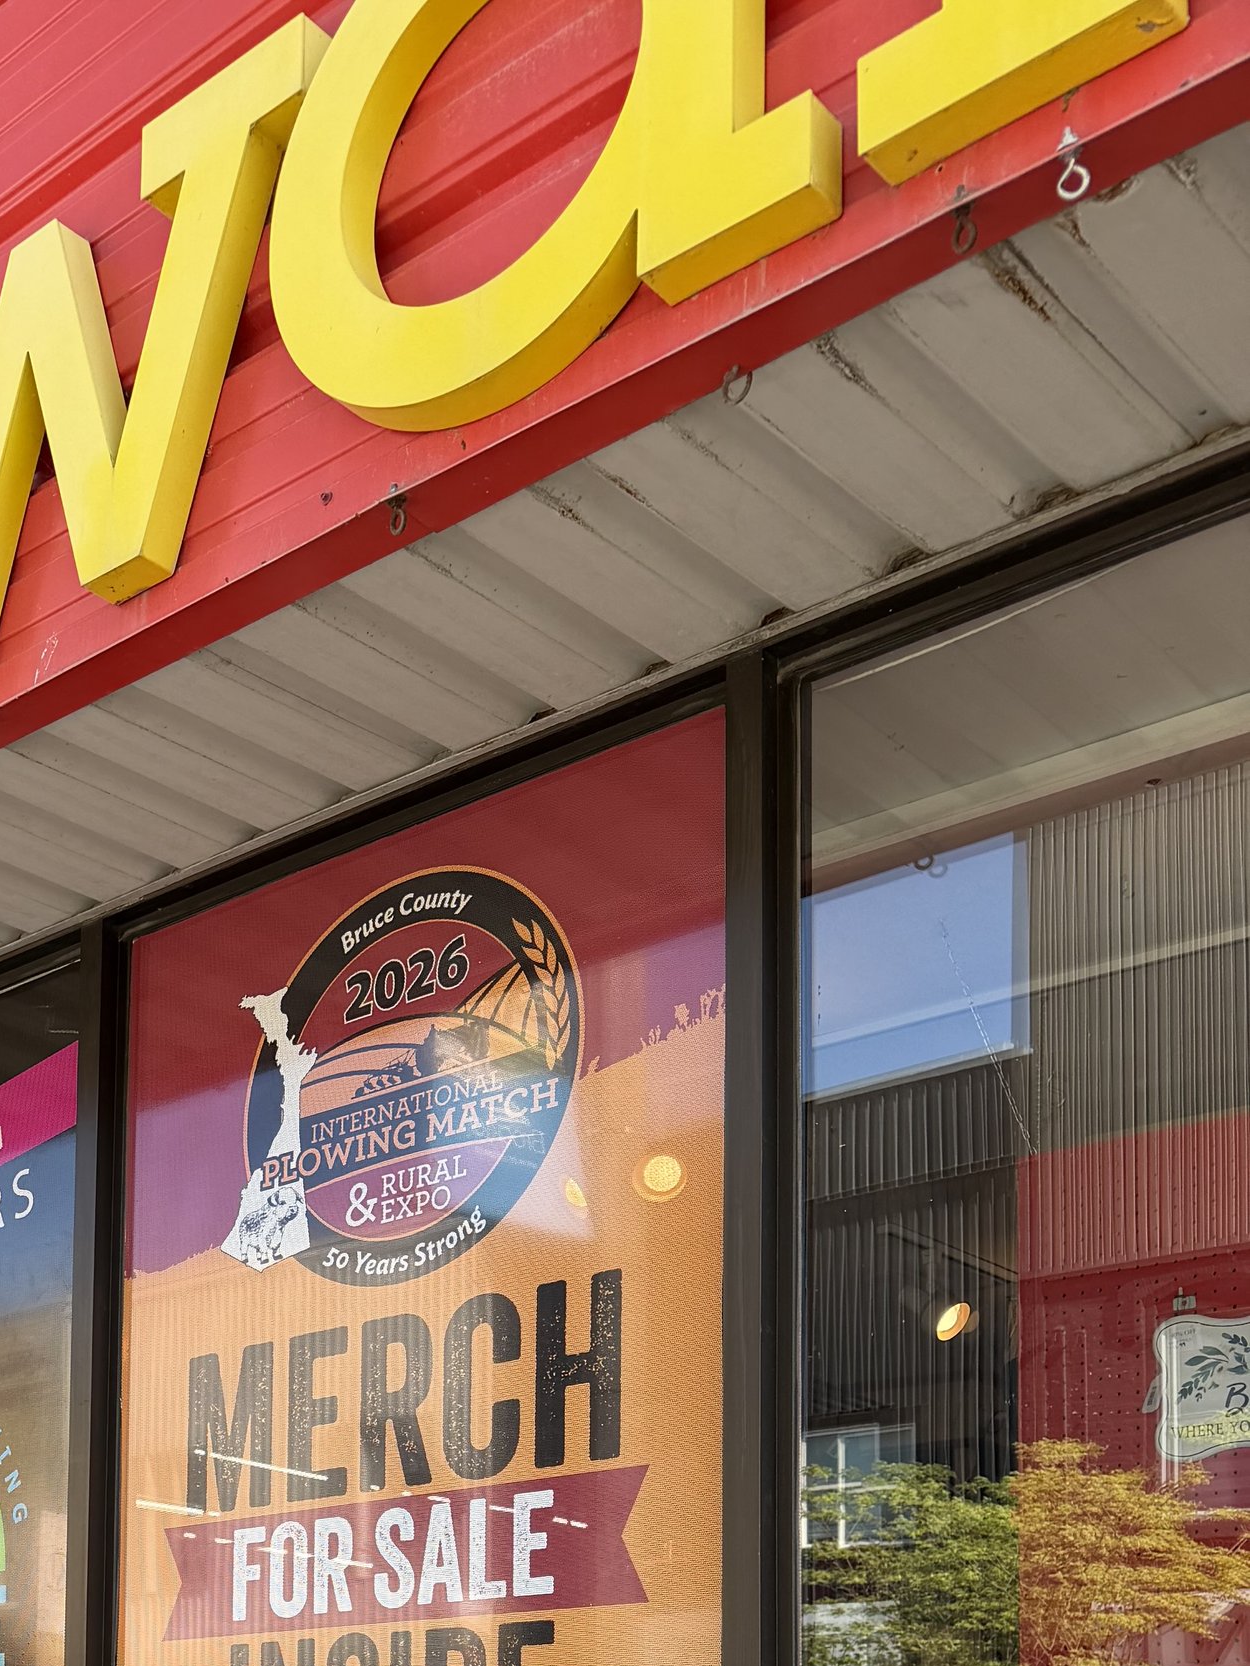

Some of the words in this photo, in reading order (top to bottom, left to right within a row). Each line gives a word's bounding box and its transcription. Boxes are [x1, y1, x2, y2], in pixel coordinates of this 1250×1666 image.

[340, 905, 395, 955] Bruce
[399, 889, 473, 916] County
[344, 933, 470, 1024] 2026
[261, 1118, 415, 1190] PLOWING
[425, 1077, 560, 1143] MATCH
[311, 1070, 504, 1144] INTERNATIONAL
[345, 1181, 377, 1228] &
[381, 1154, 467, 1191] RURAL
[380, 1186, 452, 1225] EXPO
[323, 1247, 350, 1269] 50
[354, 1250, 409, 1275] Years
[414, 1205, 487, 1266] Strong
[186, 1268, 623, 1516] MERCH
[1172, 1422, 1224, 1439] WHERE
[1230, 1420, 1250, 1434] YO
[231, 1515, 354, 1622] FOR
[373, 1489, 555, 1610] SALE
